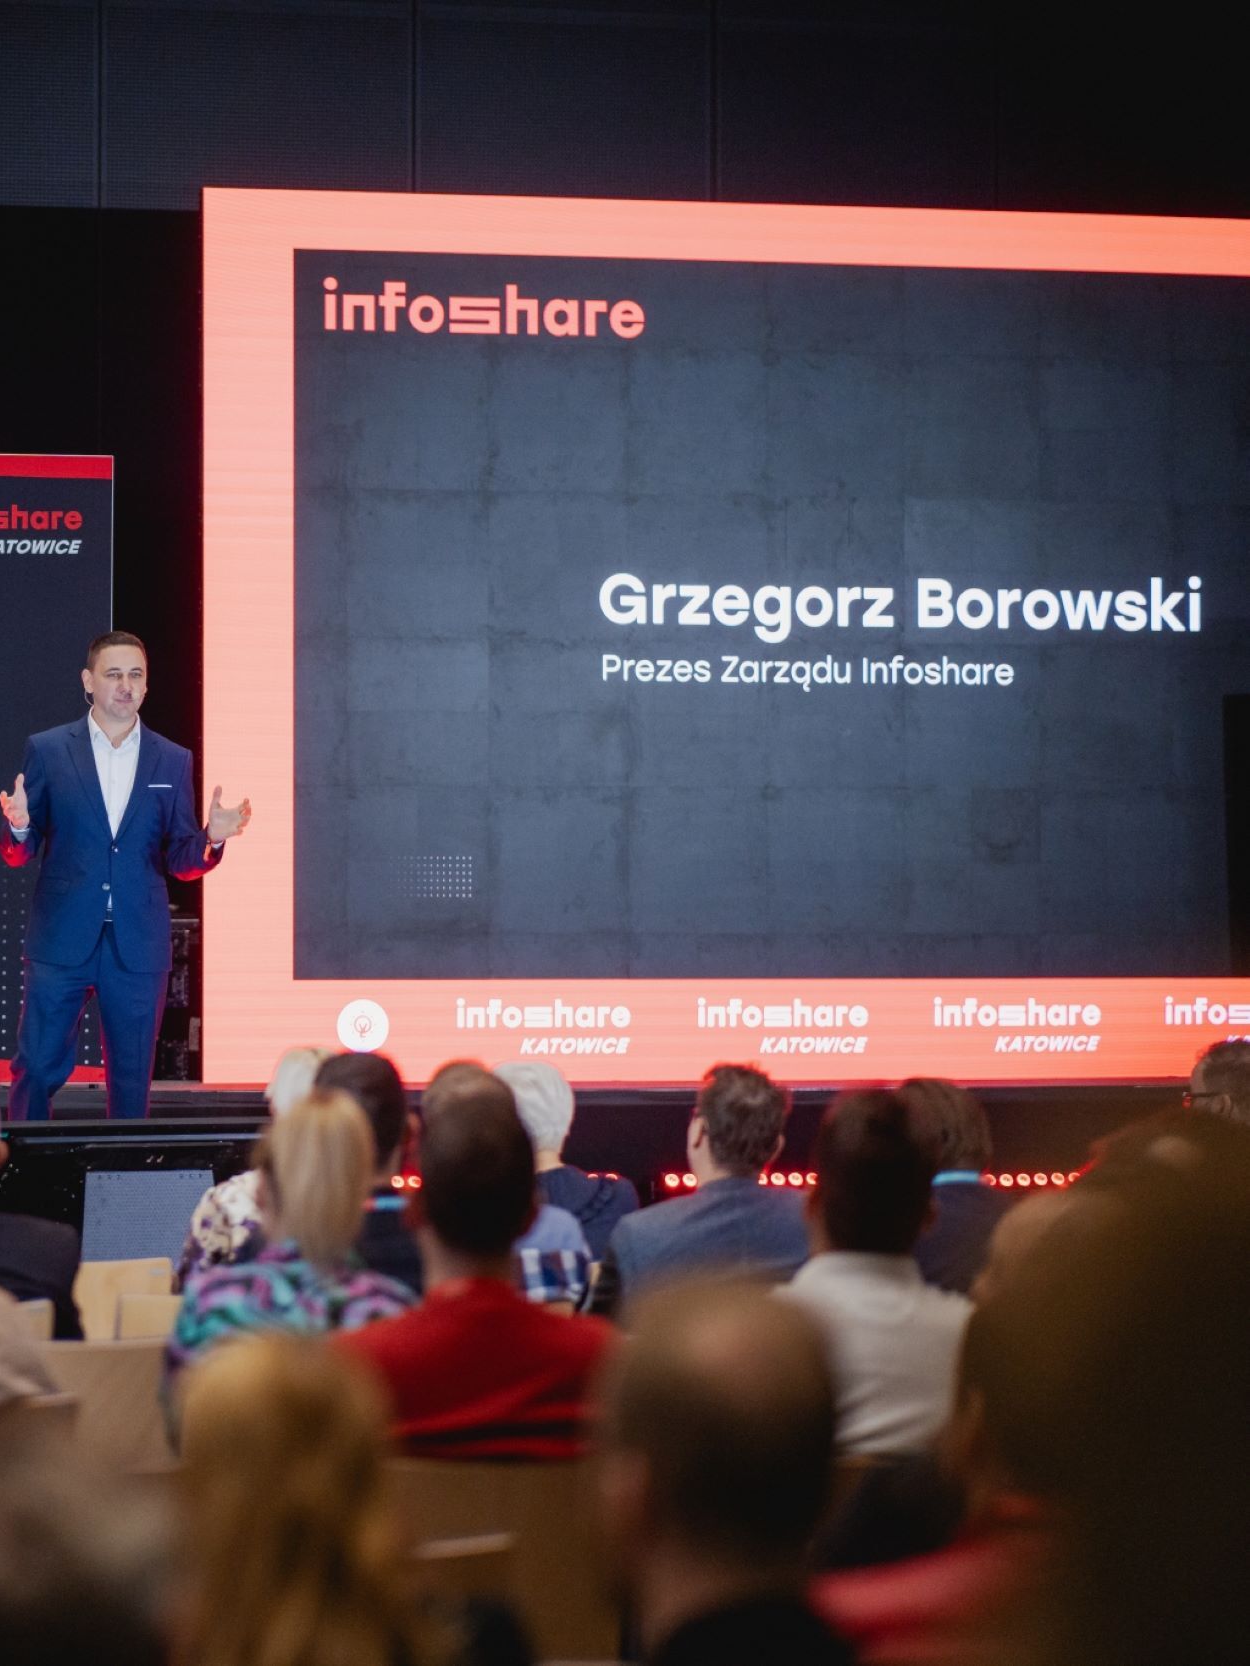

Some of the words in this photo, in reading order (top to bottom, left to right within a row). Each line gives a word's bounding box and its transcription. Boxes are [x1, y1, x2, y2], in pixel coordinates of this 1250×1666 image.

[323, 276, 645, 339] infoshare
[599, 573, 895, 643] Grzegorz
[917, 576, 1203, 632] Borowski
[601, 654, 711, 683] Prezes
[720, 655, 852, 692] Zarządu
[862, 656, 1015, 687] Infoshare
[456, 998, 631, 1029] infoshare
[697, 997, 869, 1028] infoshare
[933, 996, 1101, 1027] infoshare
[1165, 995, 1250, 1026] infos
[519, 1036, 630, 1055] KATOWICE
[759, 1035, 868, 1054] KATOWICE
[994, 1034, 1101, 1053] KATOWICE
